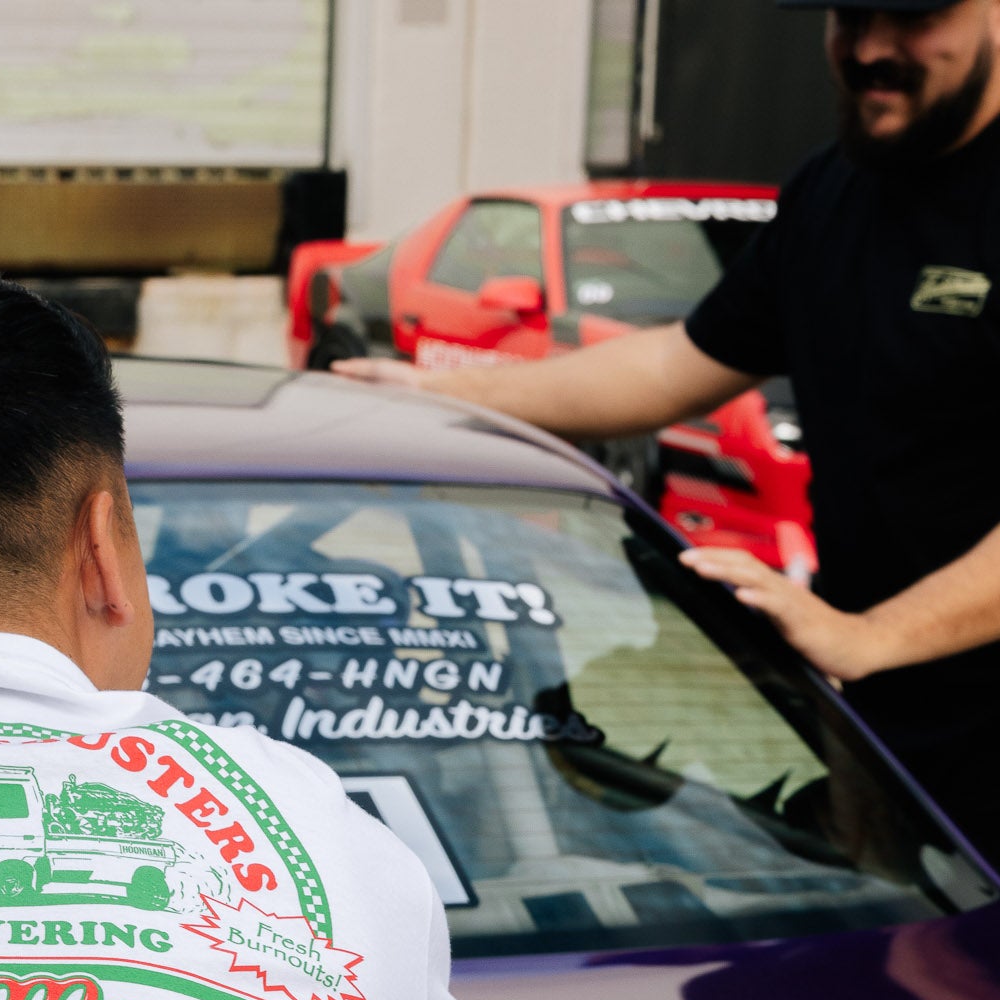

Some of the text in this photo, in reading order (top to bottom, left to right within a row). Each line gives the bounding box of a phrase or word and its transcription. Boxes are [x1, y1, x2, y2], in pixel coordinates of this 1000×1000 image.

[411, 576, 556, 625] IT!
[153, 626, 478, 649] AYHEM SINCE MMXI
[141, 657, 503, 692] -464-HNGN
[227, 926, 342, 992] Burnouts!
[257, 922, 321, 962] Fresh
